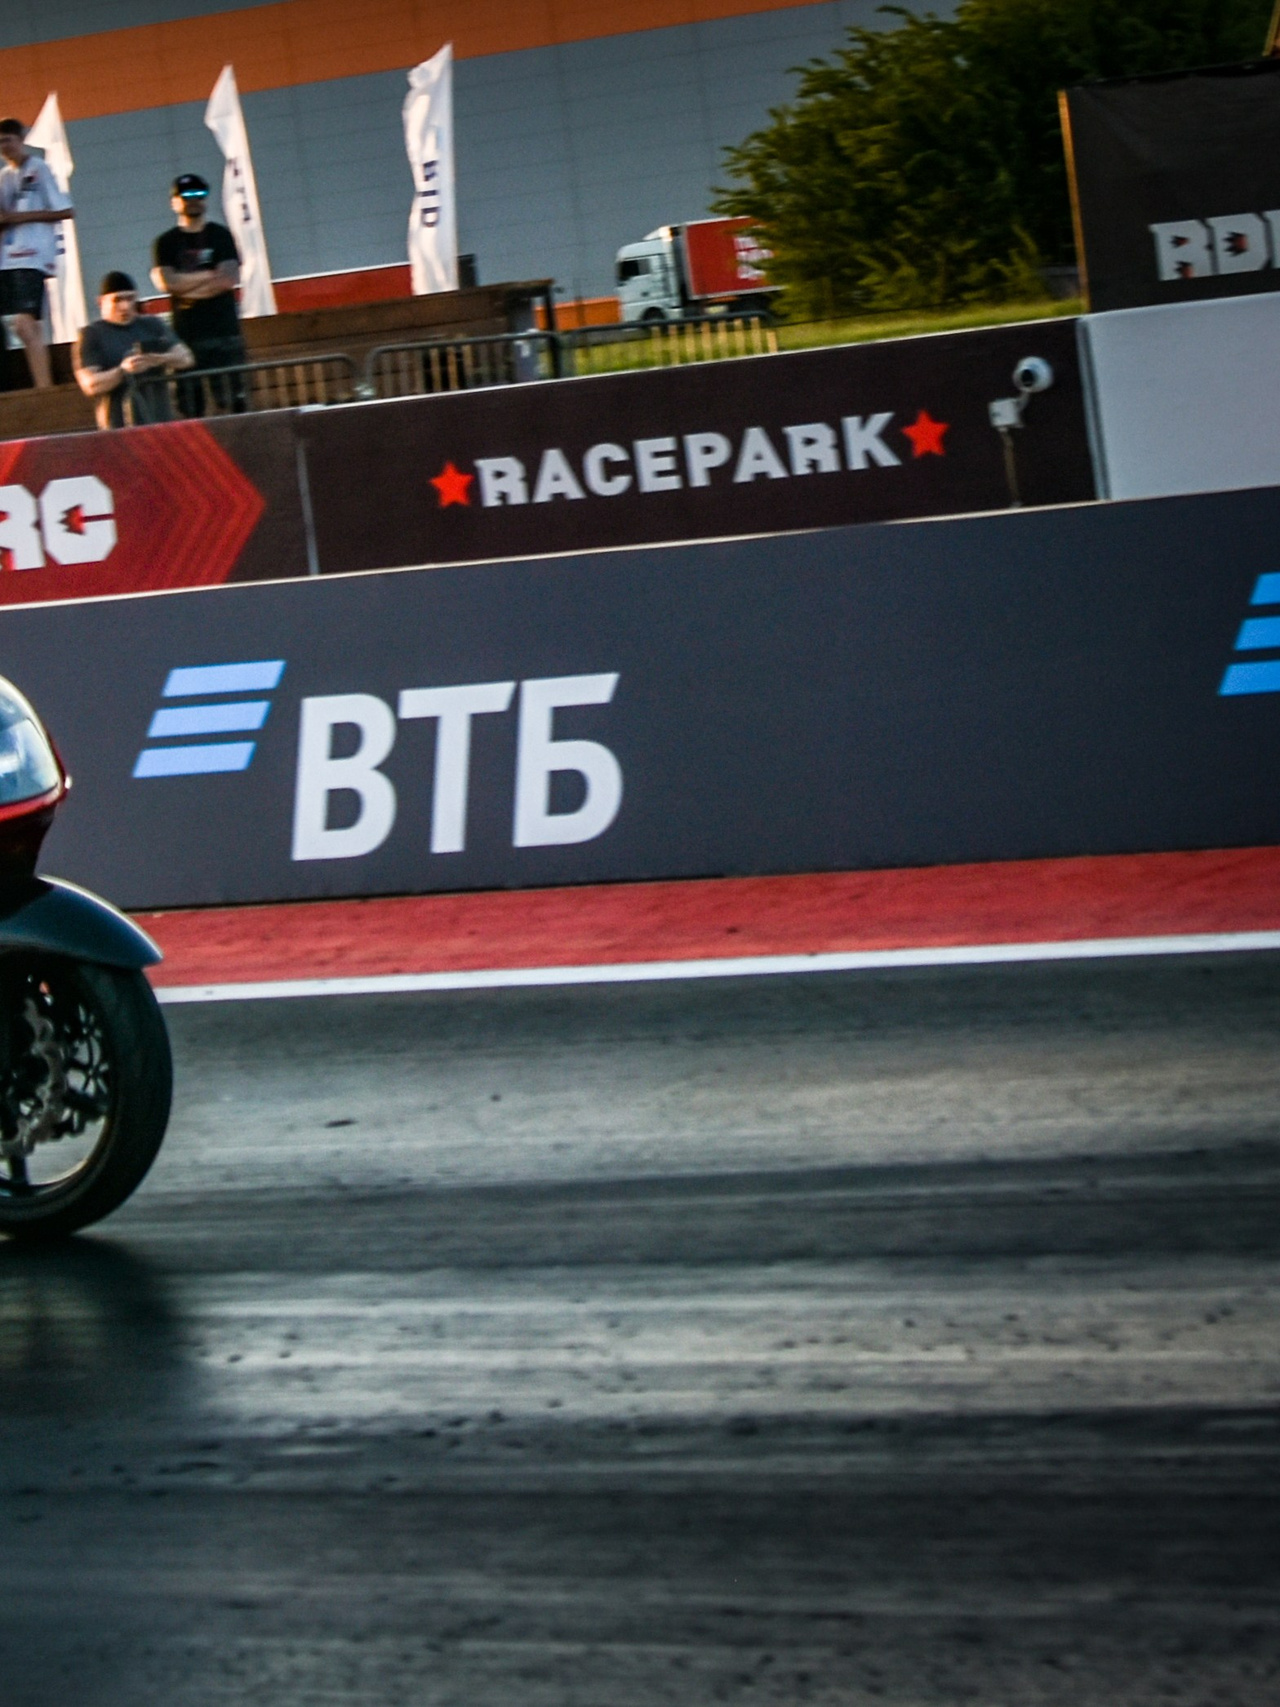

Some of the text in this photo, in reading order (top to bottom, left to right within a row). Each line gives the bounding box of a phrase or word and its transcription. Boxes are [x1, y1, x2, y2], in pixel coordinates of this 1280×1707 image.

[1148, 208, 1280, 281] RD
[474, 411, 902, 508] RACEPARK
[291, 673, 623, 861] ВТБ
